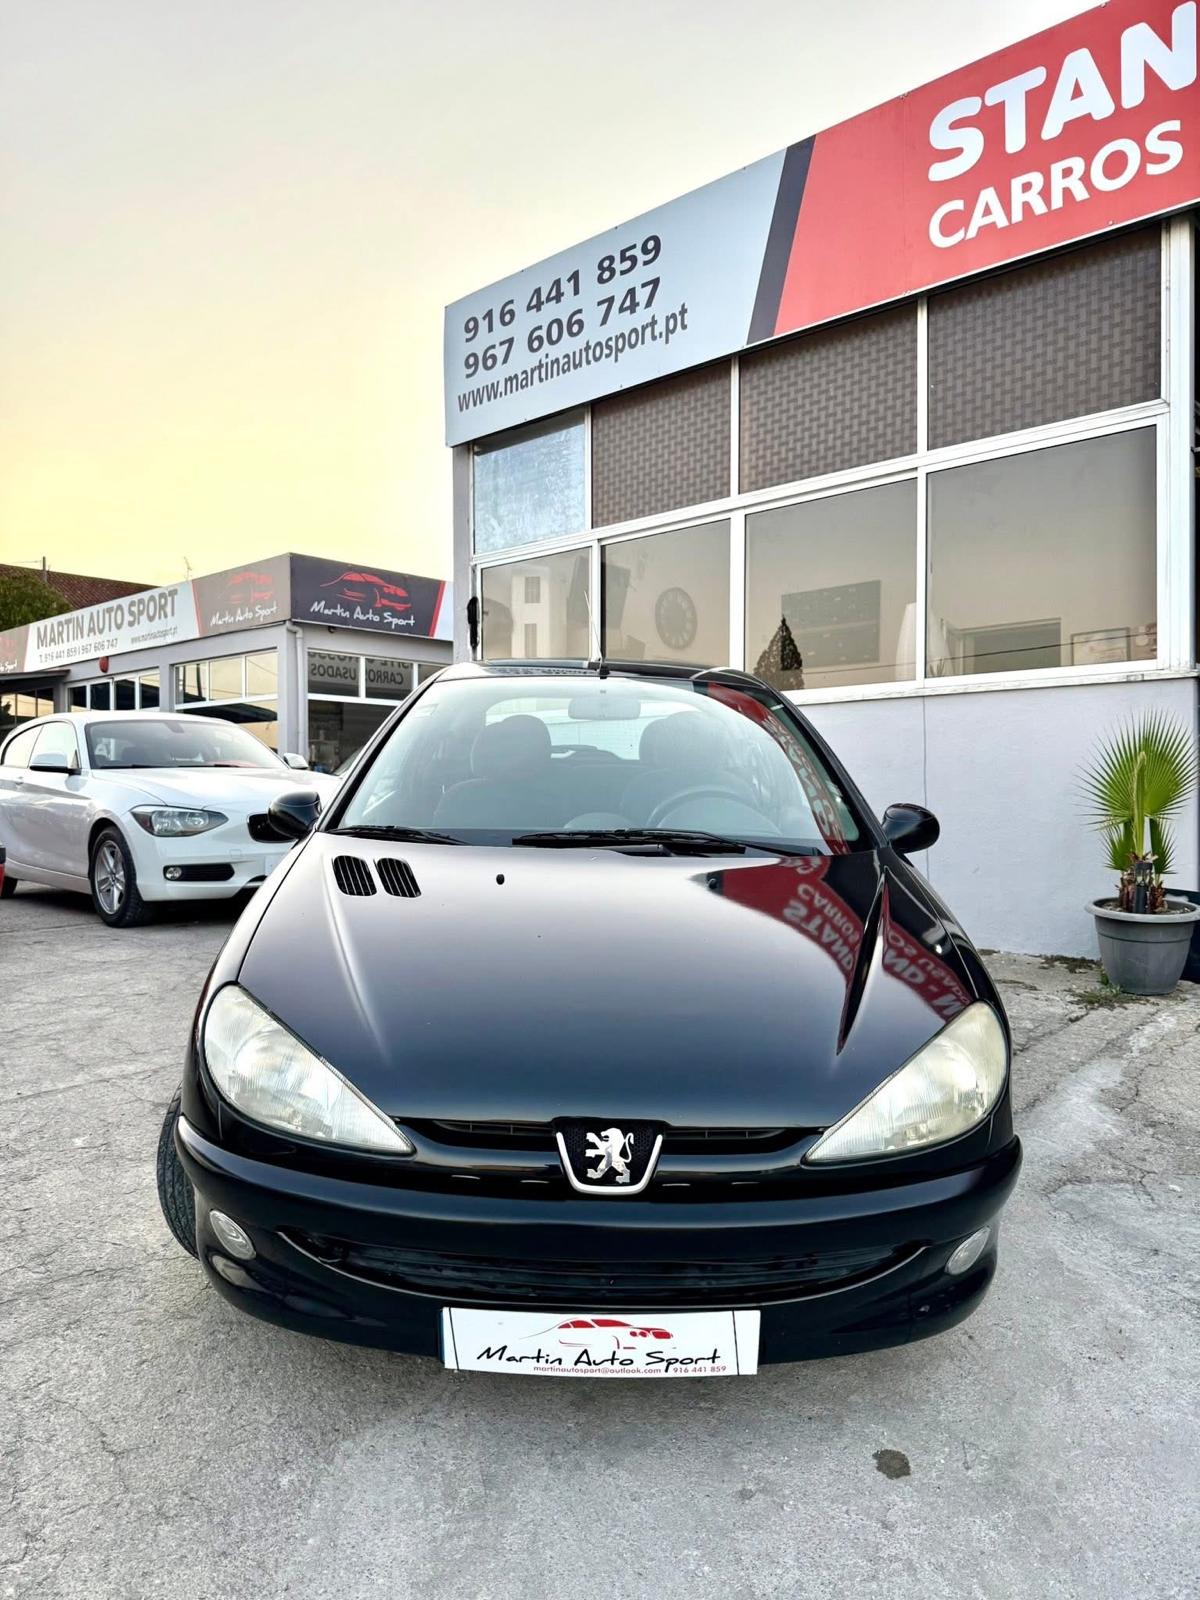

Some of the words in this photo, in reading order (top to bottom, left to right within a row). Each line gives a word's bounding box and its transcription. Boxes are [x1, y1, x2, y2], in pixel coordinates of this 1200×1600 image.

[928, 1, 1197, 182] STAN
[928, 119, 1184, 248] CARROS
[464, 299, 515, 343] 916
[526, 269, 580, 313] 441
[597, 234, 662, 284] 859
[464, 336, 515, 379] 967
[527, 308, 584, 353] 606
[597, 276, 661, 327] 747
[457, 302, 688, 412] www.martinautosport.pt
[36, 614, 84, 650] MARTIN
[87, 603, 125, 637] AUTO
[127, 588, 178, 628] SPORT
[209, 612, 234, 626] Martin
[235, 608, 253, 622] Auto
[255, 600, 278, 621] Sport
[310, 600, 350, 618] Martin
[353, 605, 380, 622] Auto
[383, 612, 416, 629] Sport
[476, 1345, 562, 1365] Martin
[574, 1348, 634, 1366] Auto
[645, 1348, 721, 1373] Sport
[533, 1365, 661, 1374] martinautosport@outlook.com
[673, 1366, 689, 1374] 916
[710, 1365, 727, 1373] 859
